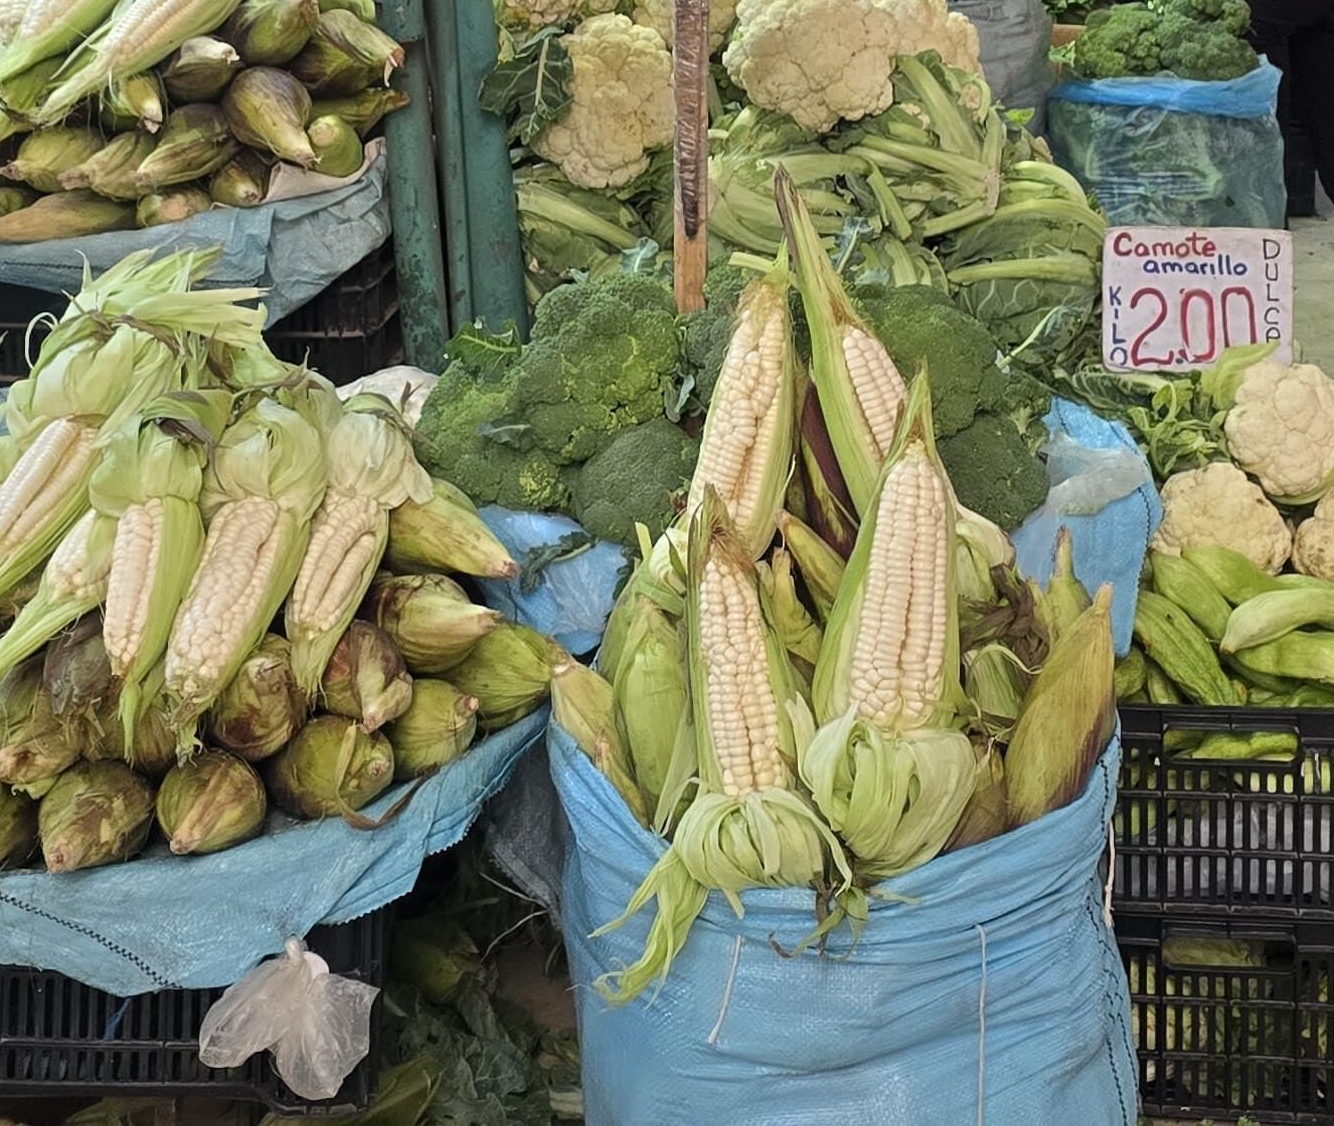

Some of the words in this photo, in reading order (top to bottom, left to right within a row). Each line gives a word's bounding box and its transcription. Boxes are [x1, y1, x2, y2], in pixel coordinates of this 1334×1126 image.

[1113, 231, 1217, 259] Camote
[1142, 254, 1248, 276] amarillo
[1109, 285, 1129, 366] KILO
[1130, 285, 1259, 367] 2.00
